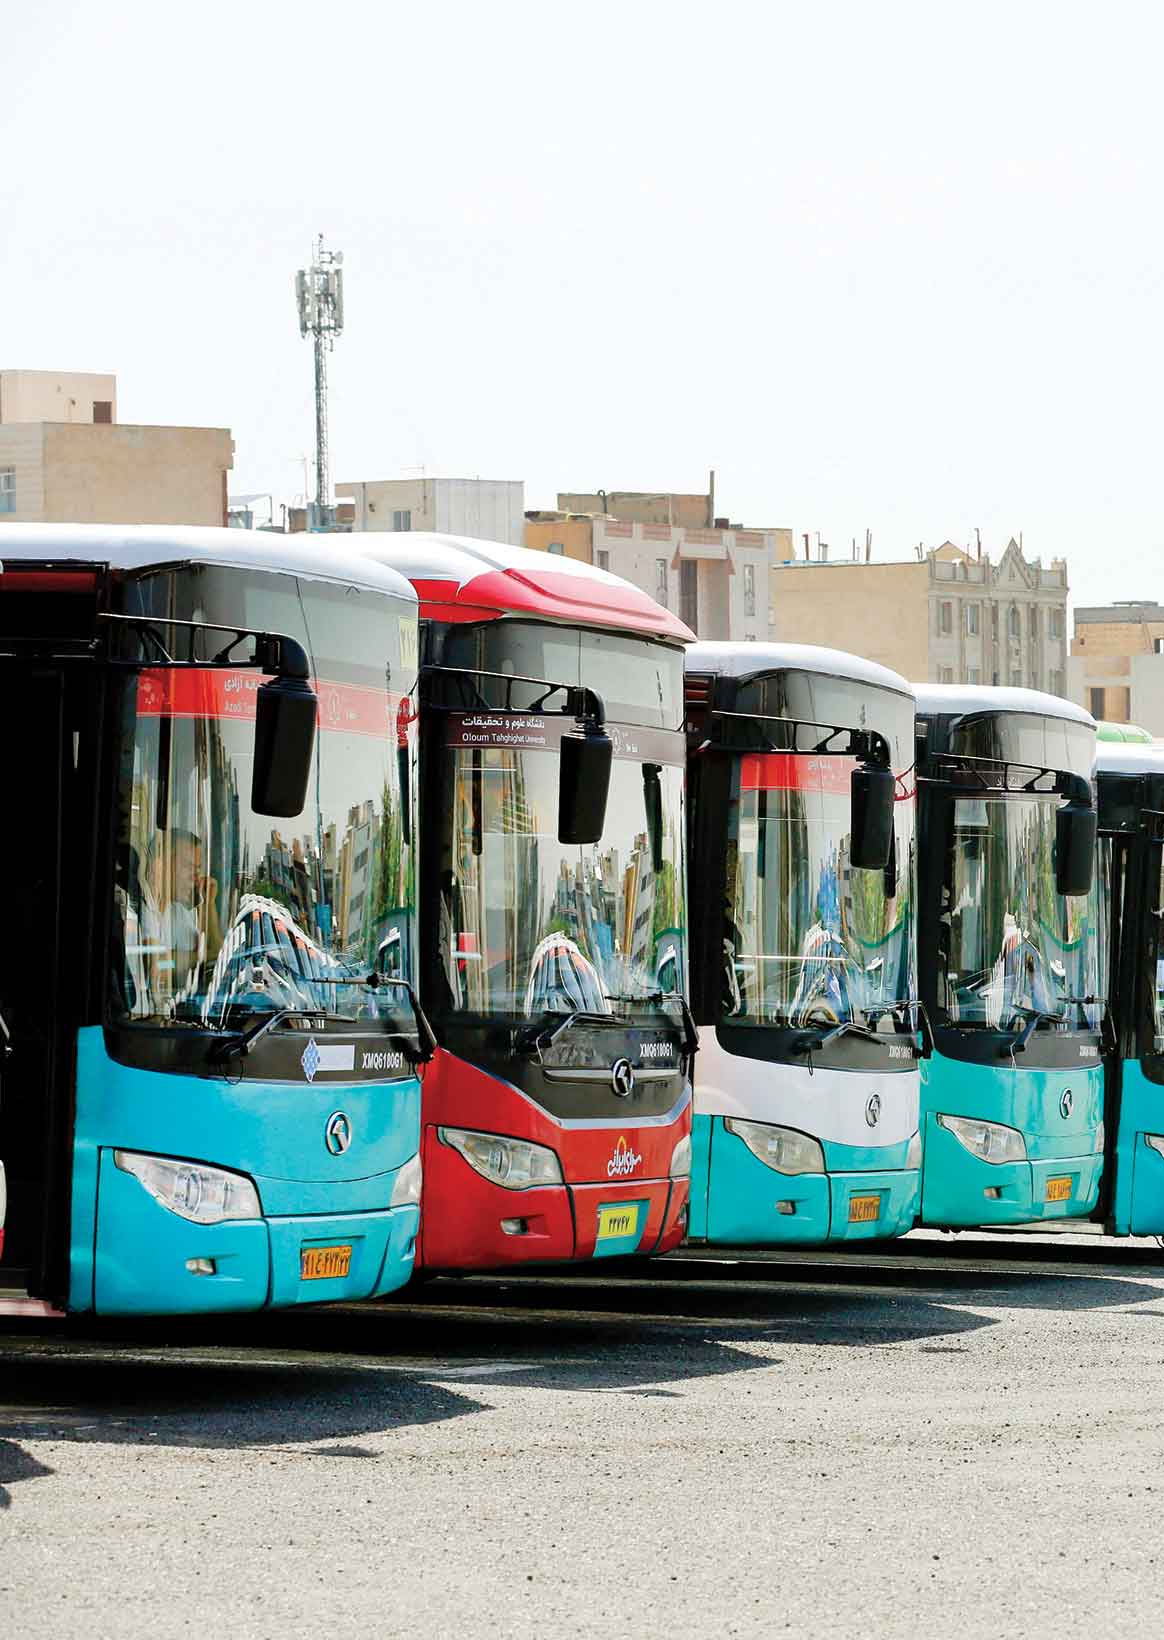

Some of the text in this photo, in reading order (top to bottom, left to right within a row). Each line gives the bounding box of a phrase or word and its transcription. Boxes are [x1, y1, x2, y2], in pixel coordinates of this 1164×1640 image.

[462, 716, 504, 729] تحقیقات
[505, 719, 511, 729] و
[511, 718, 526, 731] علوم
[462, 733, 490, 742] Oloum
[639, 1043, 674, 1058] XMQ6180G1
[362, 1052, 404, 1071] XMQ6180G1
